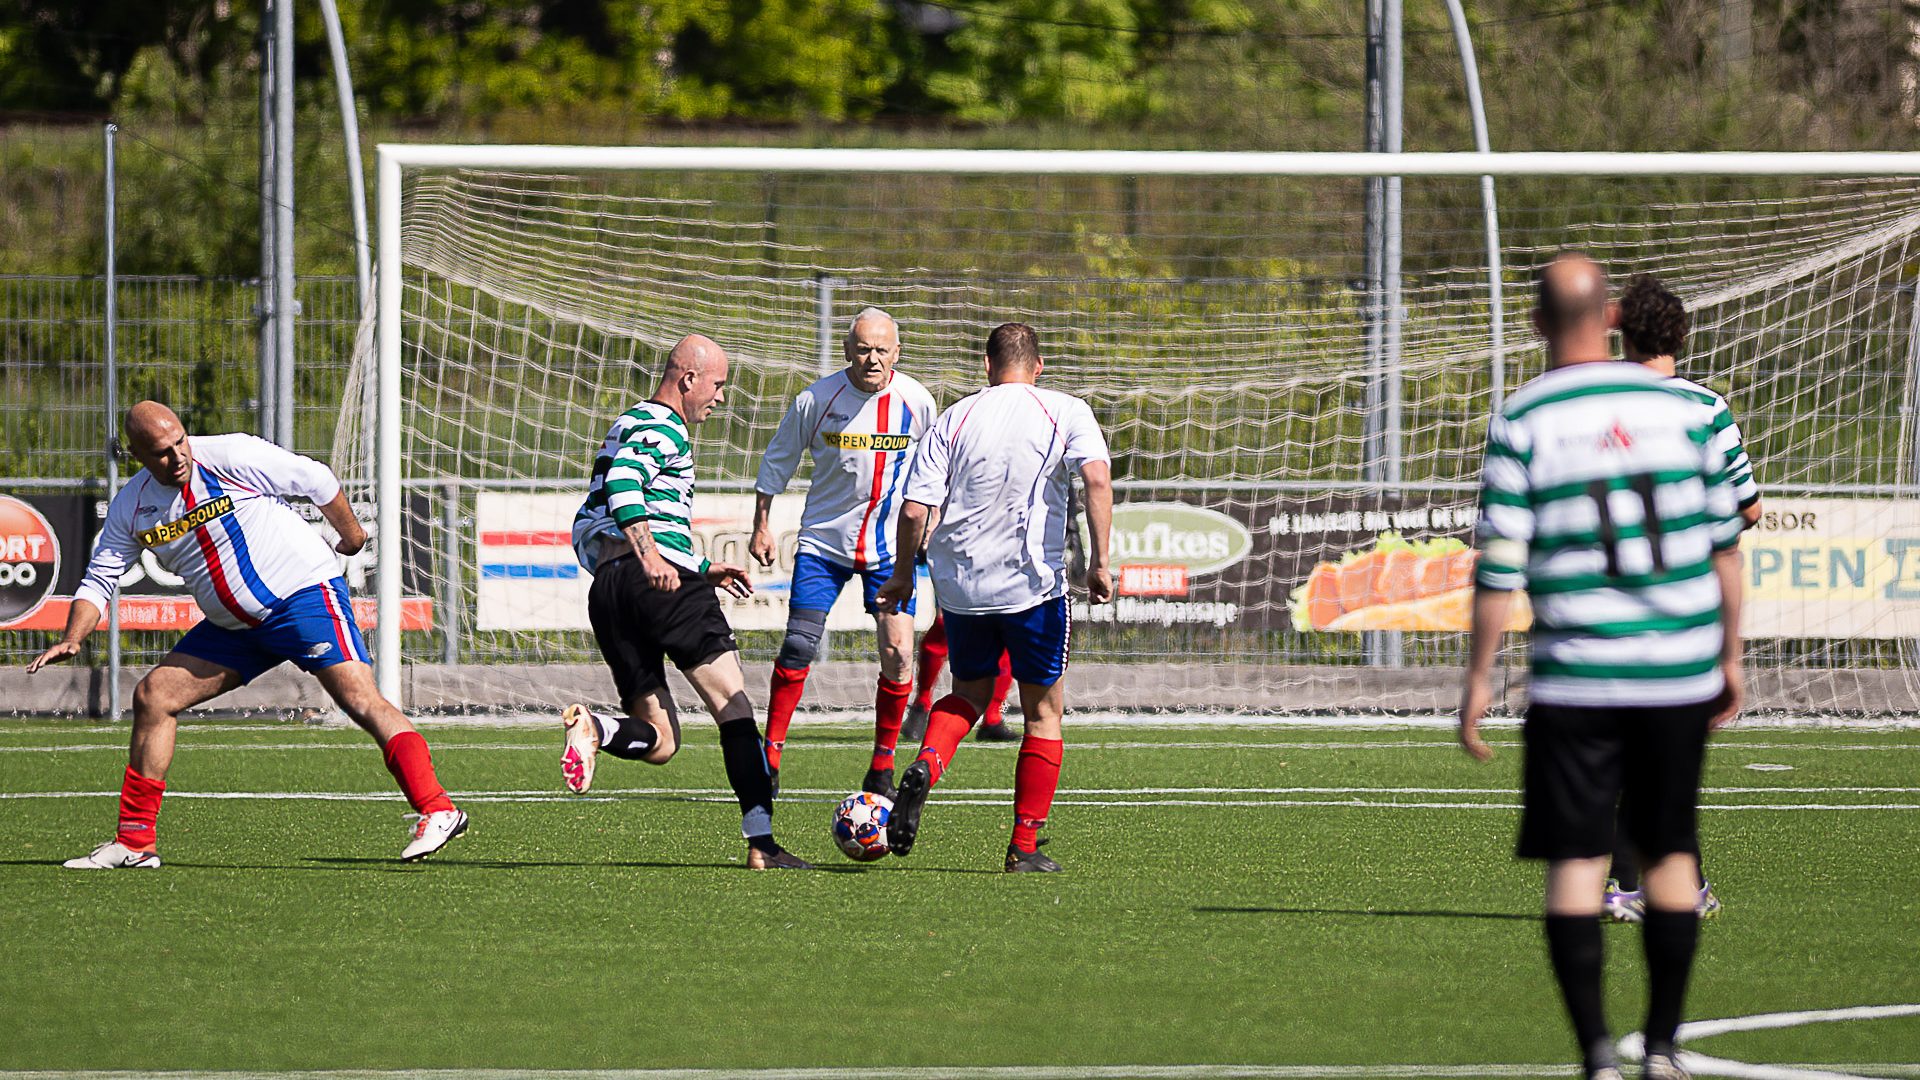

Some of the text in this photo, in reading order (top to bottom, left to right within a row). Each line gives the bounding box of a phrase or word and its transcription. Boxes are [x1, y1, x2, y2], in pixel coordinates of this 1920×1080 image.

[873, 436, 909, 450] BOUW
[188, 497, 231, 528] BOUW
[1586, 472, 1666, 577] 11
[1754, 511, 1816, 531] SOR
[1110, 523, 1229, 559] ufkes
[1736, 547, 1866, 588] PEN
